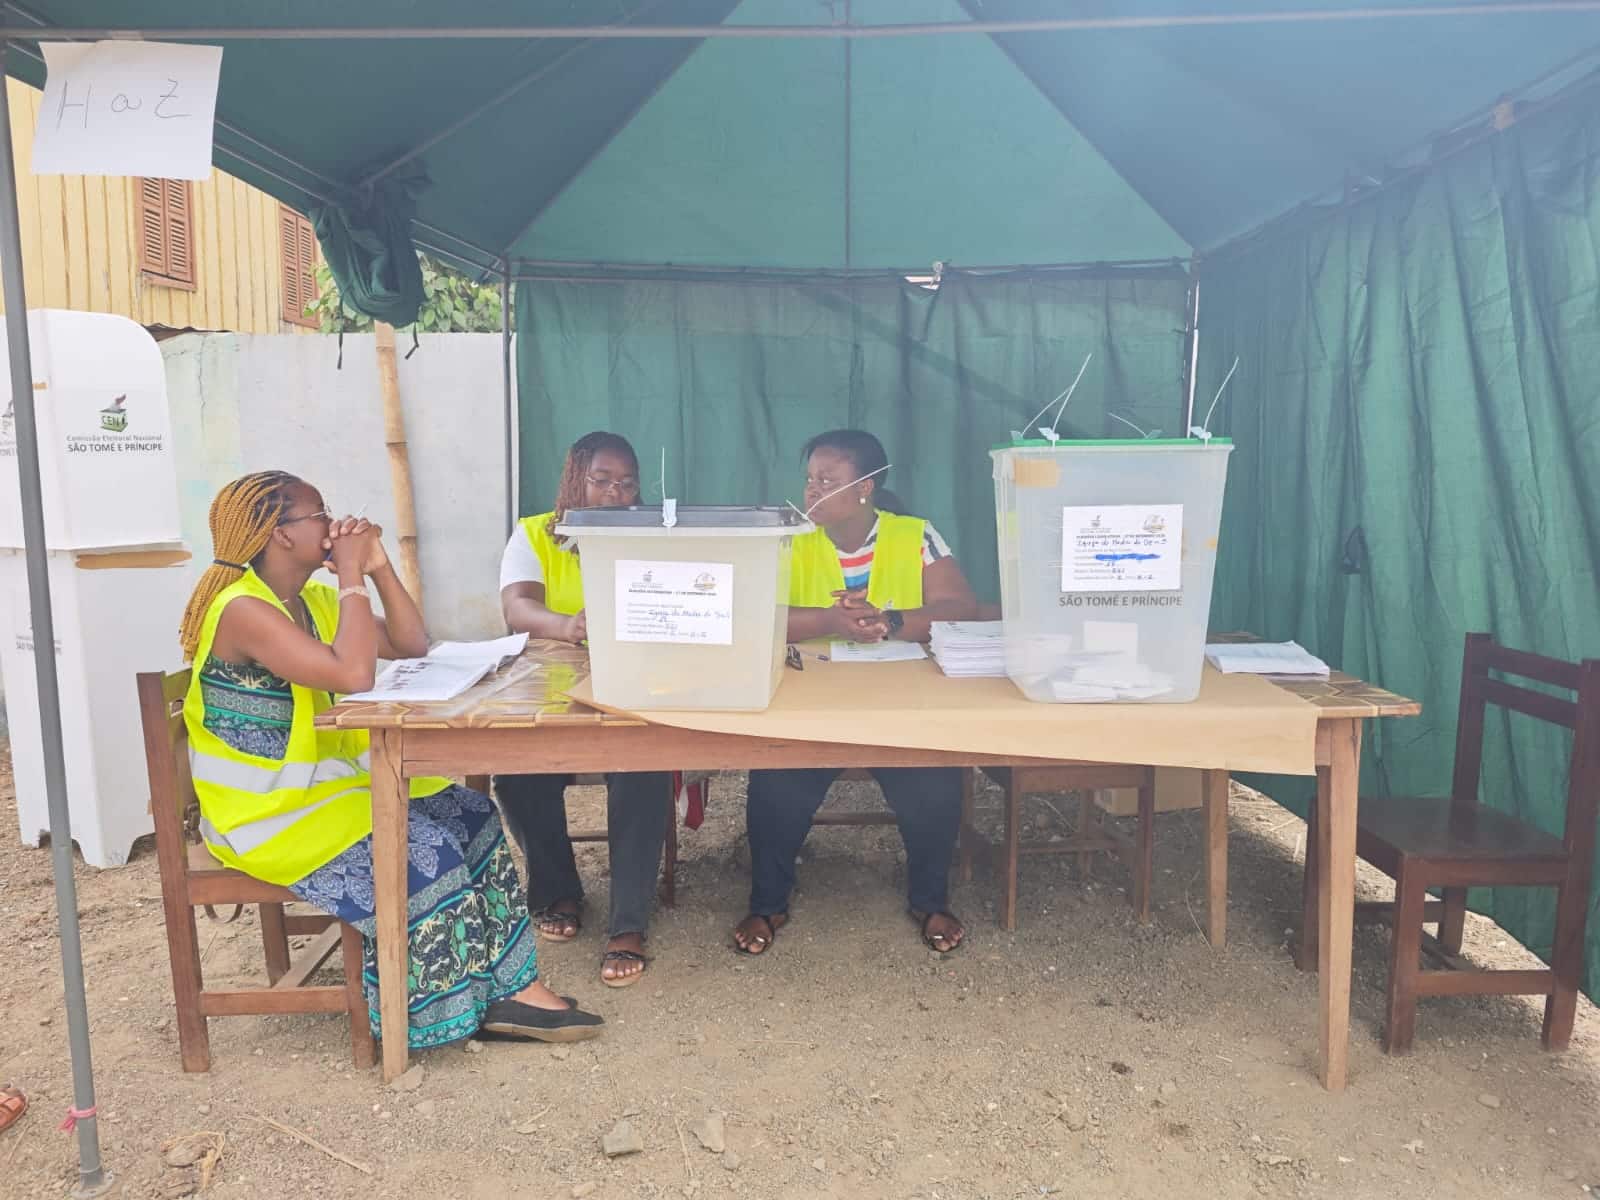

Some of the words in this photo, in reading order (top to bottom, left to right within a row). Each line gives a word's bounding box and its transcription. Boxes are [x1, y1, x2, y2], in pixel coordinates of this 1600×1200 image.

[68, 441, 87, 452] SÃO
[117, 443, 123, 451] E
[1059, 594, 1083, 607] SÃO
[1121, 596, 1129, 606] E
[1131, 594, 1183, 607] PRÍNCIPE
